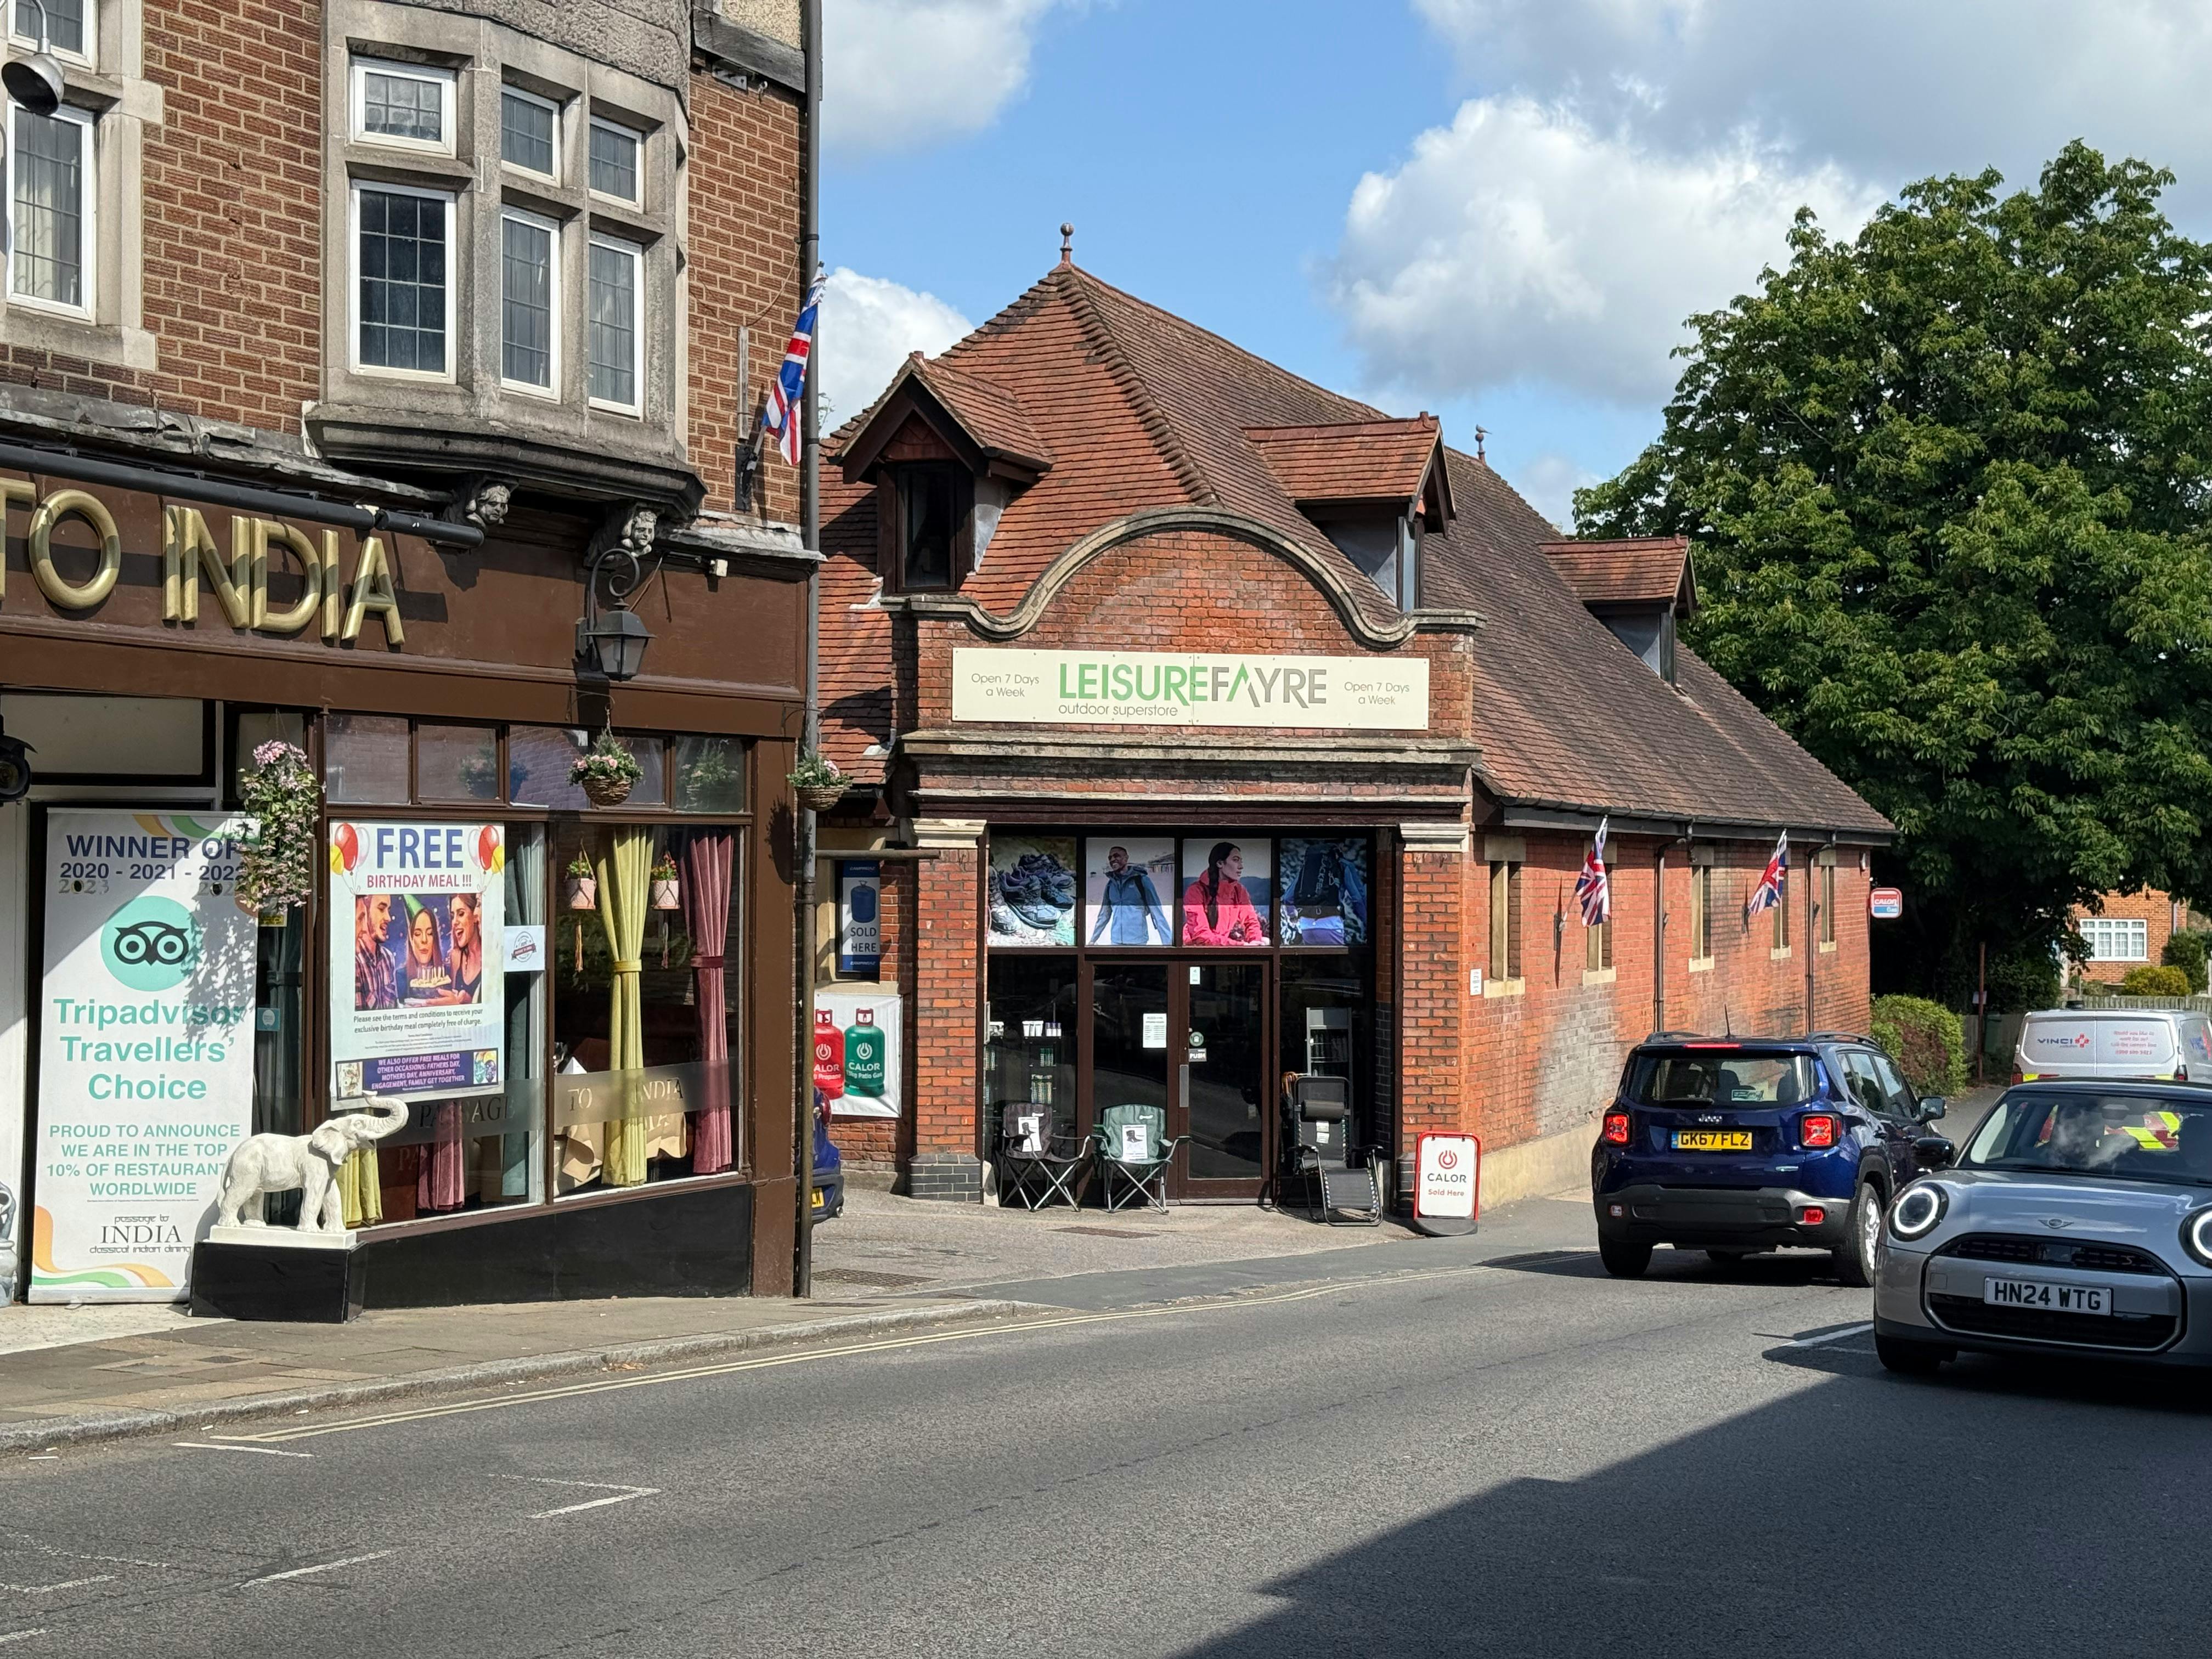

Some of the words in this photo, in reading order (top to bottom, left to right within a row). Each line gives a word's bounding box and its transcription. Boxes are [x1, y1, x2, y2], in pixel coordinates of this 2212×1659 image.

[162, 505, 405, 646] INDIA
[971, 673, 1002, 684] Open
[1005, 674, 1011, 683] 7
[1014, 674, 1040, 685] Days
[1059, 662, 1327, 708] LEISUREFAYRE
[996, 687, 1025, 697] Week
[1344, 681, 1373, 693] Open
[1376, 683, 1382, 691] 7
[1386, 682, 1410, 693] Days
[1368, 695, 1395, 706] Week
[1059, 703, 1109, 715] outdoor
[1113, 704, 1178, 718] superstore
[66, 834, 190, 860] WINNER
[201, 837, 242, 860] OF
[377, 828, 463, 868] FREE
[60, 862, 109, 878] 2020
[129, 864, 176, 880] 2021
[367, 874, 426, 888] BIRTHDAY
[428, 874, 460, 888] MEAL
[850, 927, 877, 937] SOLD
[851, 943, 877, 952] HERE
[53, 998, 246, 1031] Tripadvisor
[408, 1011, 418, 1019] and
[419, 1011, 446, 1019] conditions
[471, 1008, 483, 1017] your
[354, 1025, 380, 1034] exclusive
[380, 1024, 403, 1032] birthday
[404, 1022, 417, 1030] meal
[417, 1020, 446, 1029] completely
[427, 1061, 449, 1069] FATHERS
[814, 1064, 840, 1072] ALOR
[848, 1062, 881, 1071] CALOR
[381, 1072, 406, 1081] MOTHERS
[408, 1077, 427, 1086] FAMILY
[438, 1075, 465, 1083] TOGETHER
[89, 1074, 207, 1099] Choice
[568, 1087, 592, 1111] TO
[1699, 1114, 1723, 1124] Jeep
[49, 1125, 110, 1138] PROUD
[116, 1125, 138, 1137] TO
[143, 1124, 240, 1137] ANNOUNCE
[1681, 1132, 1717, 1146] GK67
[1721, 1132, 1749, 1146] FLZ
[61, 1144, 88, 1157] WE
[93, 1144, 128, 1156] ARE
[134, 1144, 150, 1156] IN
[155, 1144, 189, 1156] THE
[194, 1143, 228, 1156] TOP
[47, 1164, 80, 1177] 10%
[86, 1164, 109, 1176] OF
[1427, 1173, 1467, 1183] CALOR
[90, 1183, 196, 1195] WORDLWIDE
[114, 1215, 156, 1224] passage
[160, 1214, 170, 1222] to
[101, 1224, 183, 1244] INDIA
[89, 1245, 129, 1254] classical
[165, 1244, 192, 1255] dining
[1994, 1282, 2051, 1306] HN24
[2058, 1287, 2101, 1311] WTG
